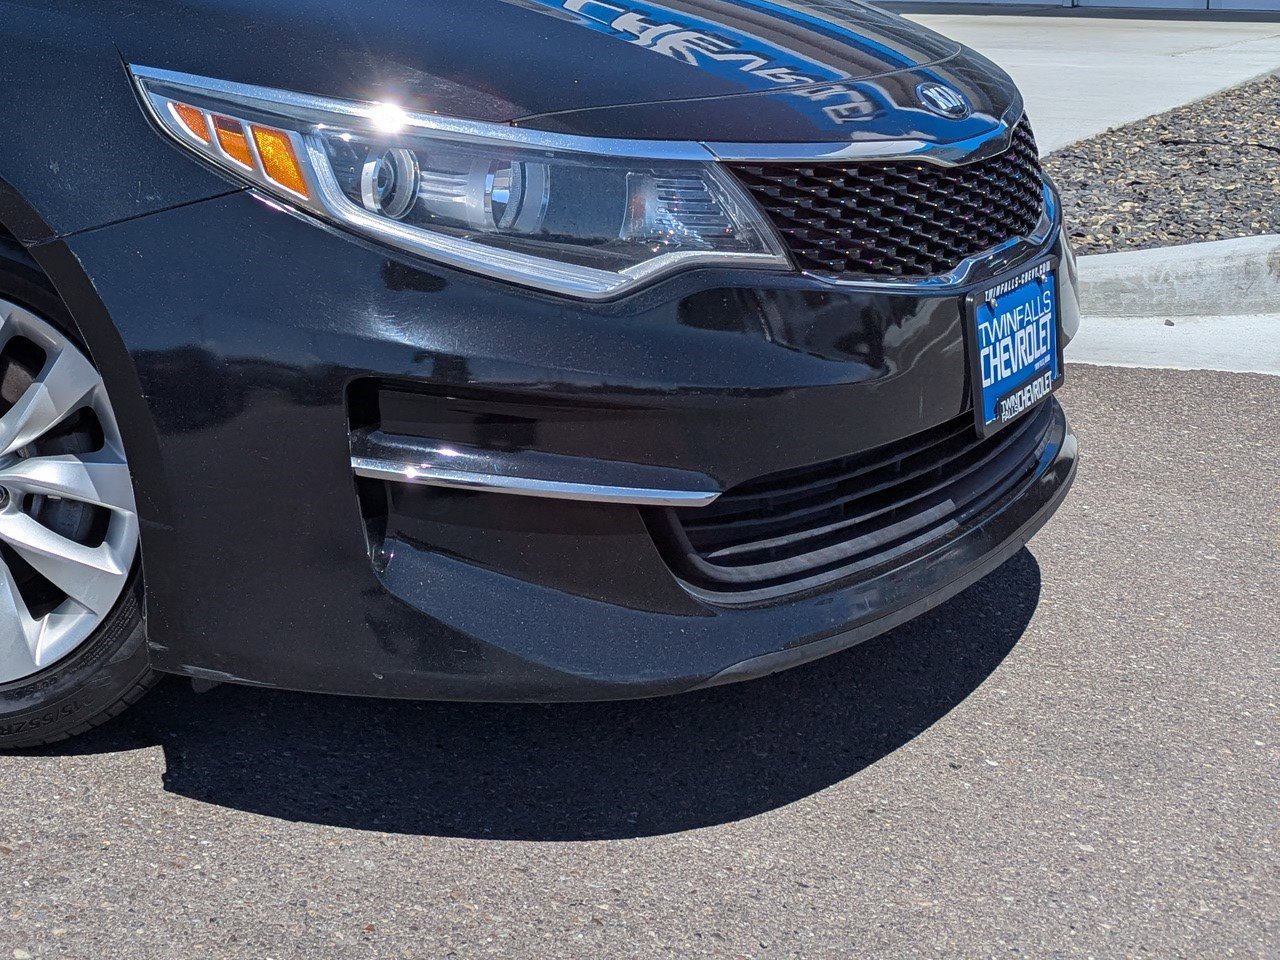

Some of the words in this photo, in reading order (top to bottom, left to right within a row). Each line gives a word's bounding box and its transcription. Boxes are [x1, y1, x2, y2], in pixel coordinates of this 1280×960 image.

[980, 312, 1052, 388] CHEVROLET
[1000, 393, 1019, 412] TWIN
[1017, 370, 1053, 413] CHEVROLET
[1001, 404, 1019, 423] FALLS
